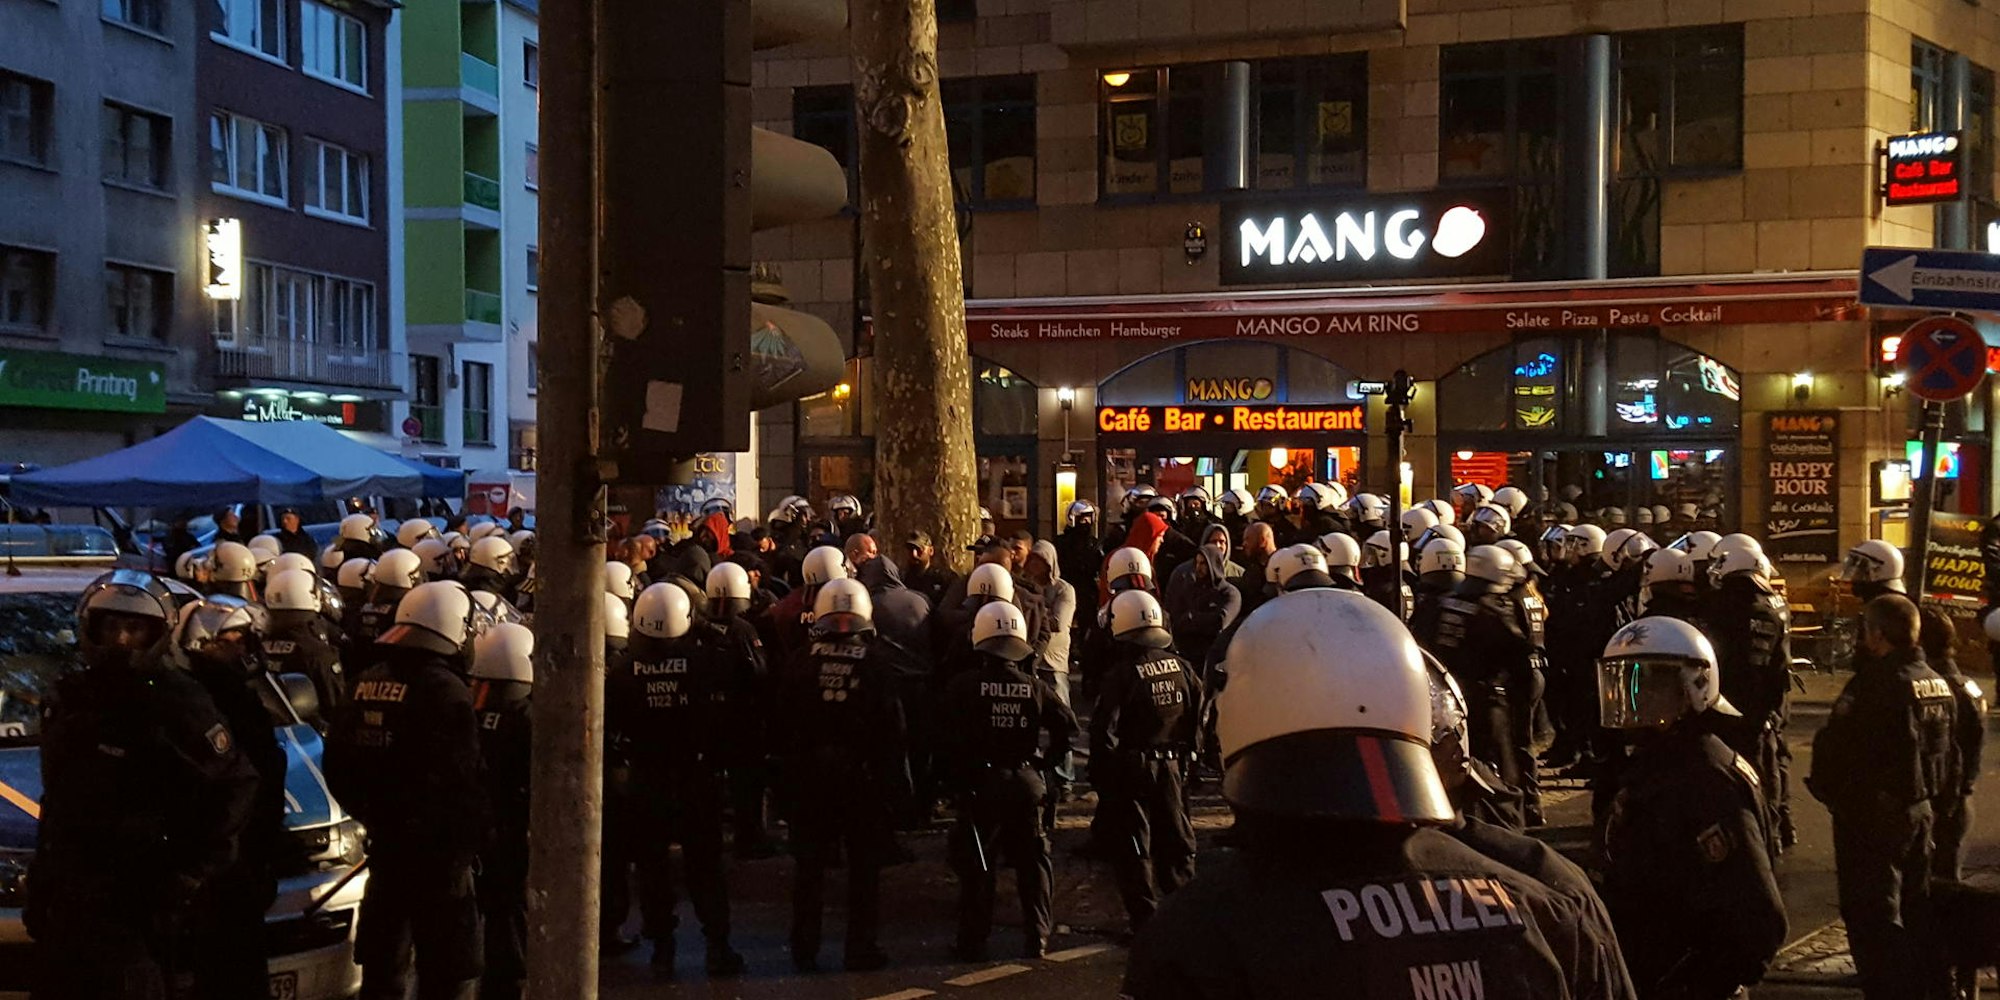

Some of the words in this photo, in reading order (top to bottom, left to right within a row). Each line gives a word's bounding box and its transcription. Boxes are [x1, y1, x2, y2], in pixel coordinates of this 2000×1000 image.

[1236, 316, 1320, 335] MANGO
[1326, 316, 1362, 333] AM
[1368, 314, 1419, 332] RING
[1506, 312, 1550, 328] Salate
[1562, 310, 1598, 326] Pizza
[1610, 308, 1649, 324] Pasta
[1660, 305, 1722, 323] Cocktail
[990, 323, 1029, 338] Steaks
[1039, 323, 1100, 338] Hähnchen
[1111, 321, 1181, 339] Hamburger
[77, 367, 138, 402] Printing
[1099, 406, 1150, 431] Café
[1164, 408, 1205, 431] Bar
[1233, 406, 1363, 431] Restaurant
[1769, 462, 1834, 478] HAPPY
[1774, 479, 1828, 495] HOUR
[1929, 557, 1986, 578] HAPPY
[1932, 574, 1982, 592] HOUR
[633, 657, 688, 676] POLIZEI
[1135, 658, 1182, 679] POLIZEI
[354, 680, 409, 702] POLIZEI
[646, 681, 678, 694] NRW
[980, 682, 1031, 698] POLIZEI
[1151, 680, 1175, 694] NRW
[991, 702, 1021, 715] NRW
[1151, 693, 1172, 706] 1123
[991, 716, 1014, 728] 1123
[1321, 878, 1523, 943] POLIZEI
[1408, 959, 1485, 1000] NRW
